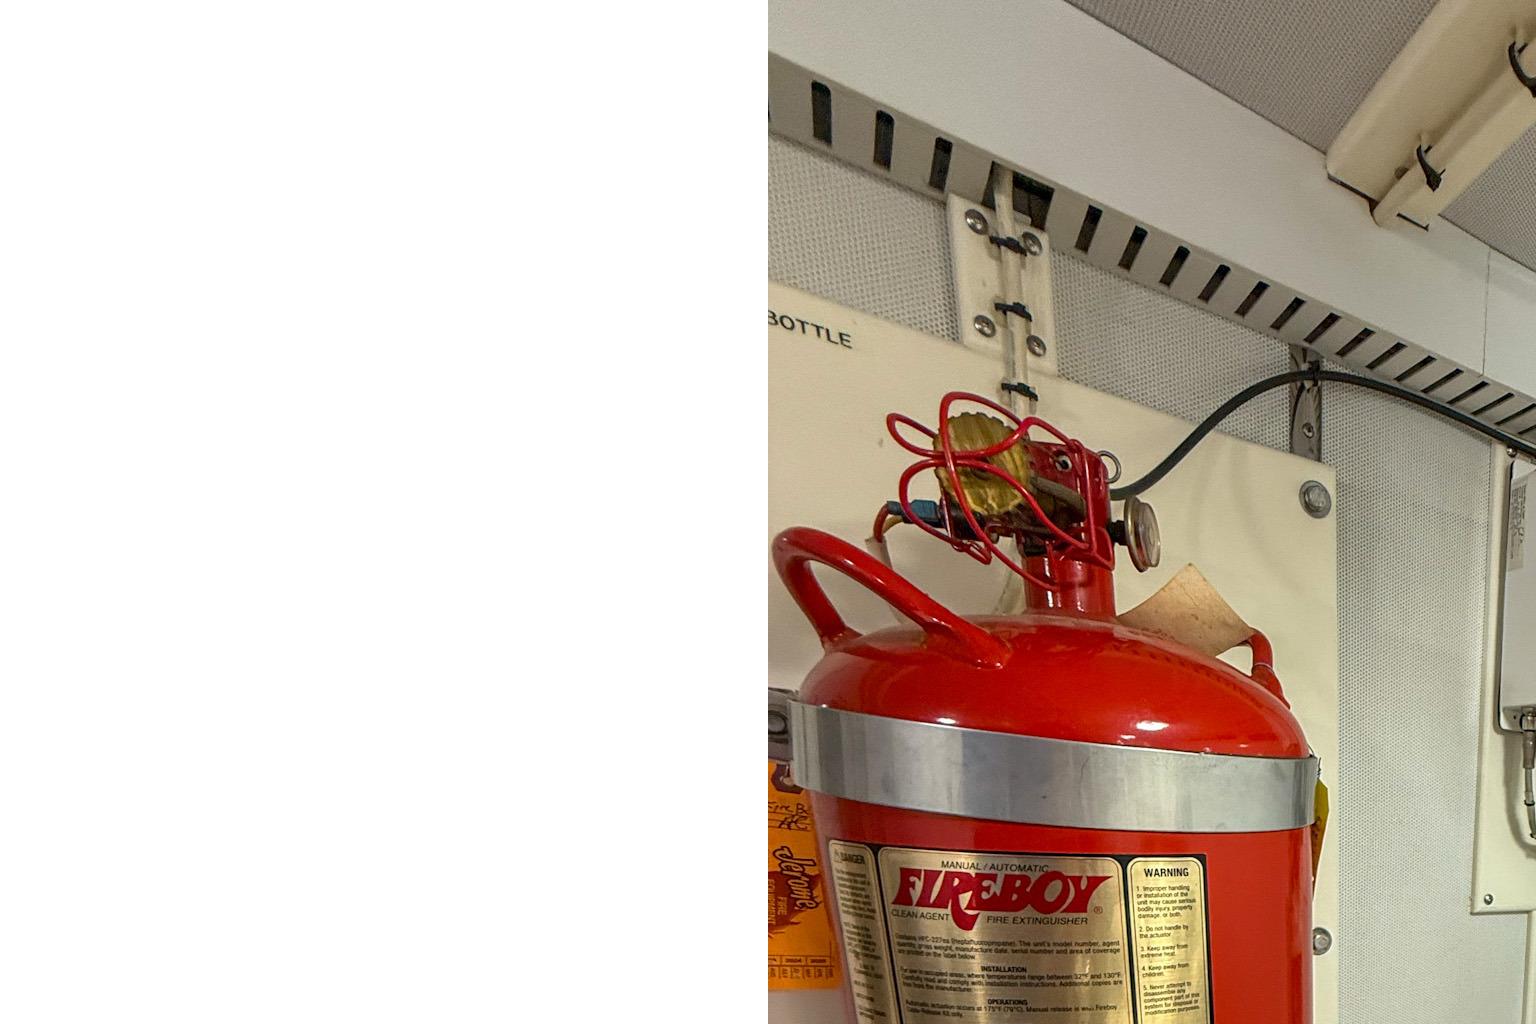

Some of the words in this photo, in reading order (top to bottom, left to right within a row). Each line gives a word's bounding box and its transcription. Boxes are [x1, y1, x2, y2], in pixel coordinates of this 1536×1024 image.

[768, 310, 852, 348] BOTTLE
[941, 860, 982, 871] MANUAL
[989, 864, 1049, 872] AUTOMATIC
[1144, 868, 1189, 877] WARNING
[773, 846, 820, 910] Jerome
[778, 896, 787, 916] FIRE
[891, 867, 1112, 931] FIREBOY
[892, 910, 918, 919] CLEAN
[919, 912, 950, 921] AGENT
[986, 916, 1010, 924] FIRE
[1012, 916, 1088, 926] EXTINGUISHER
